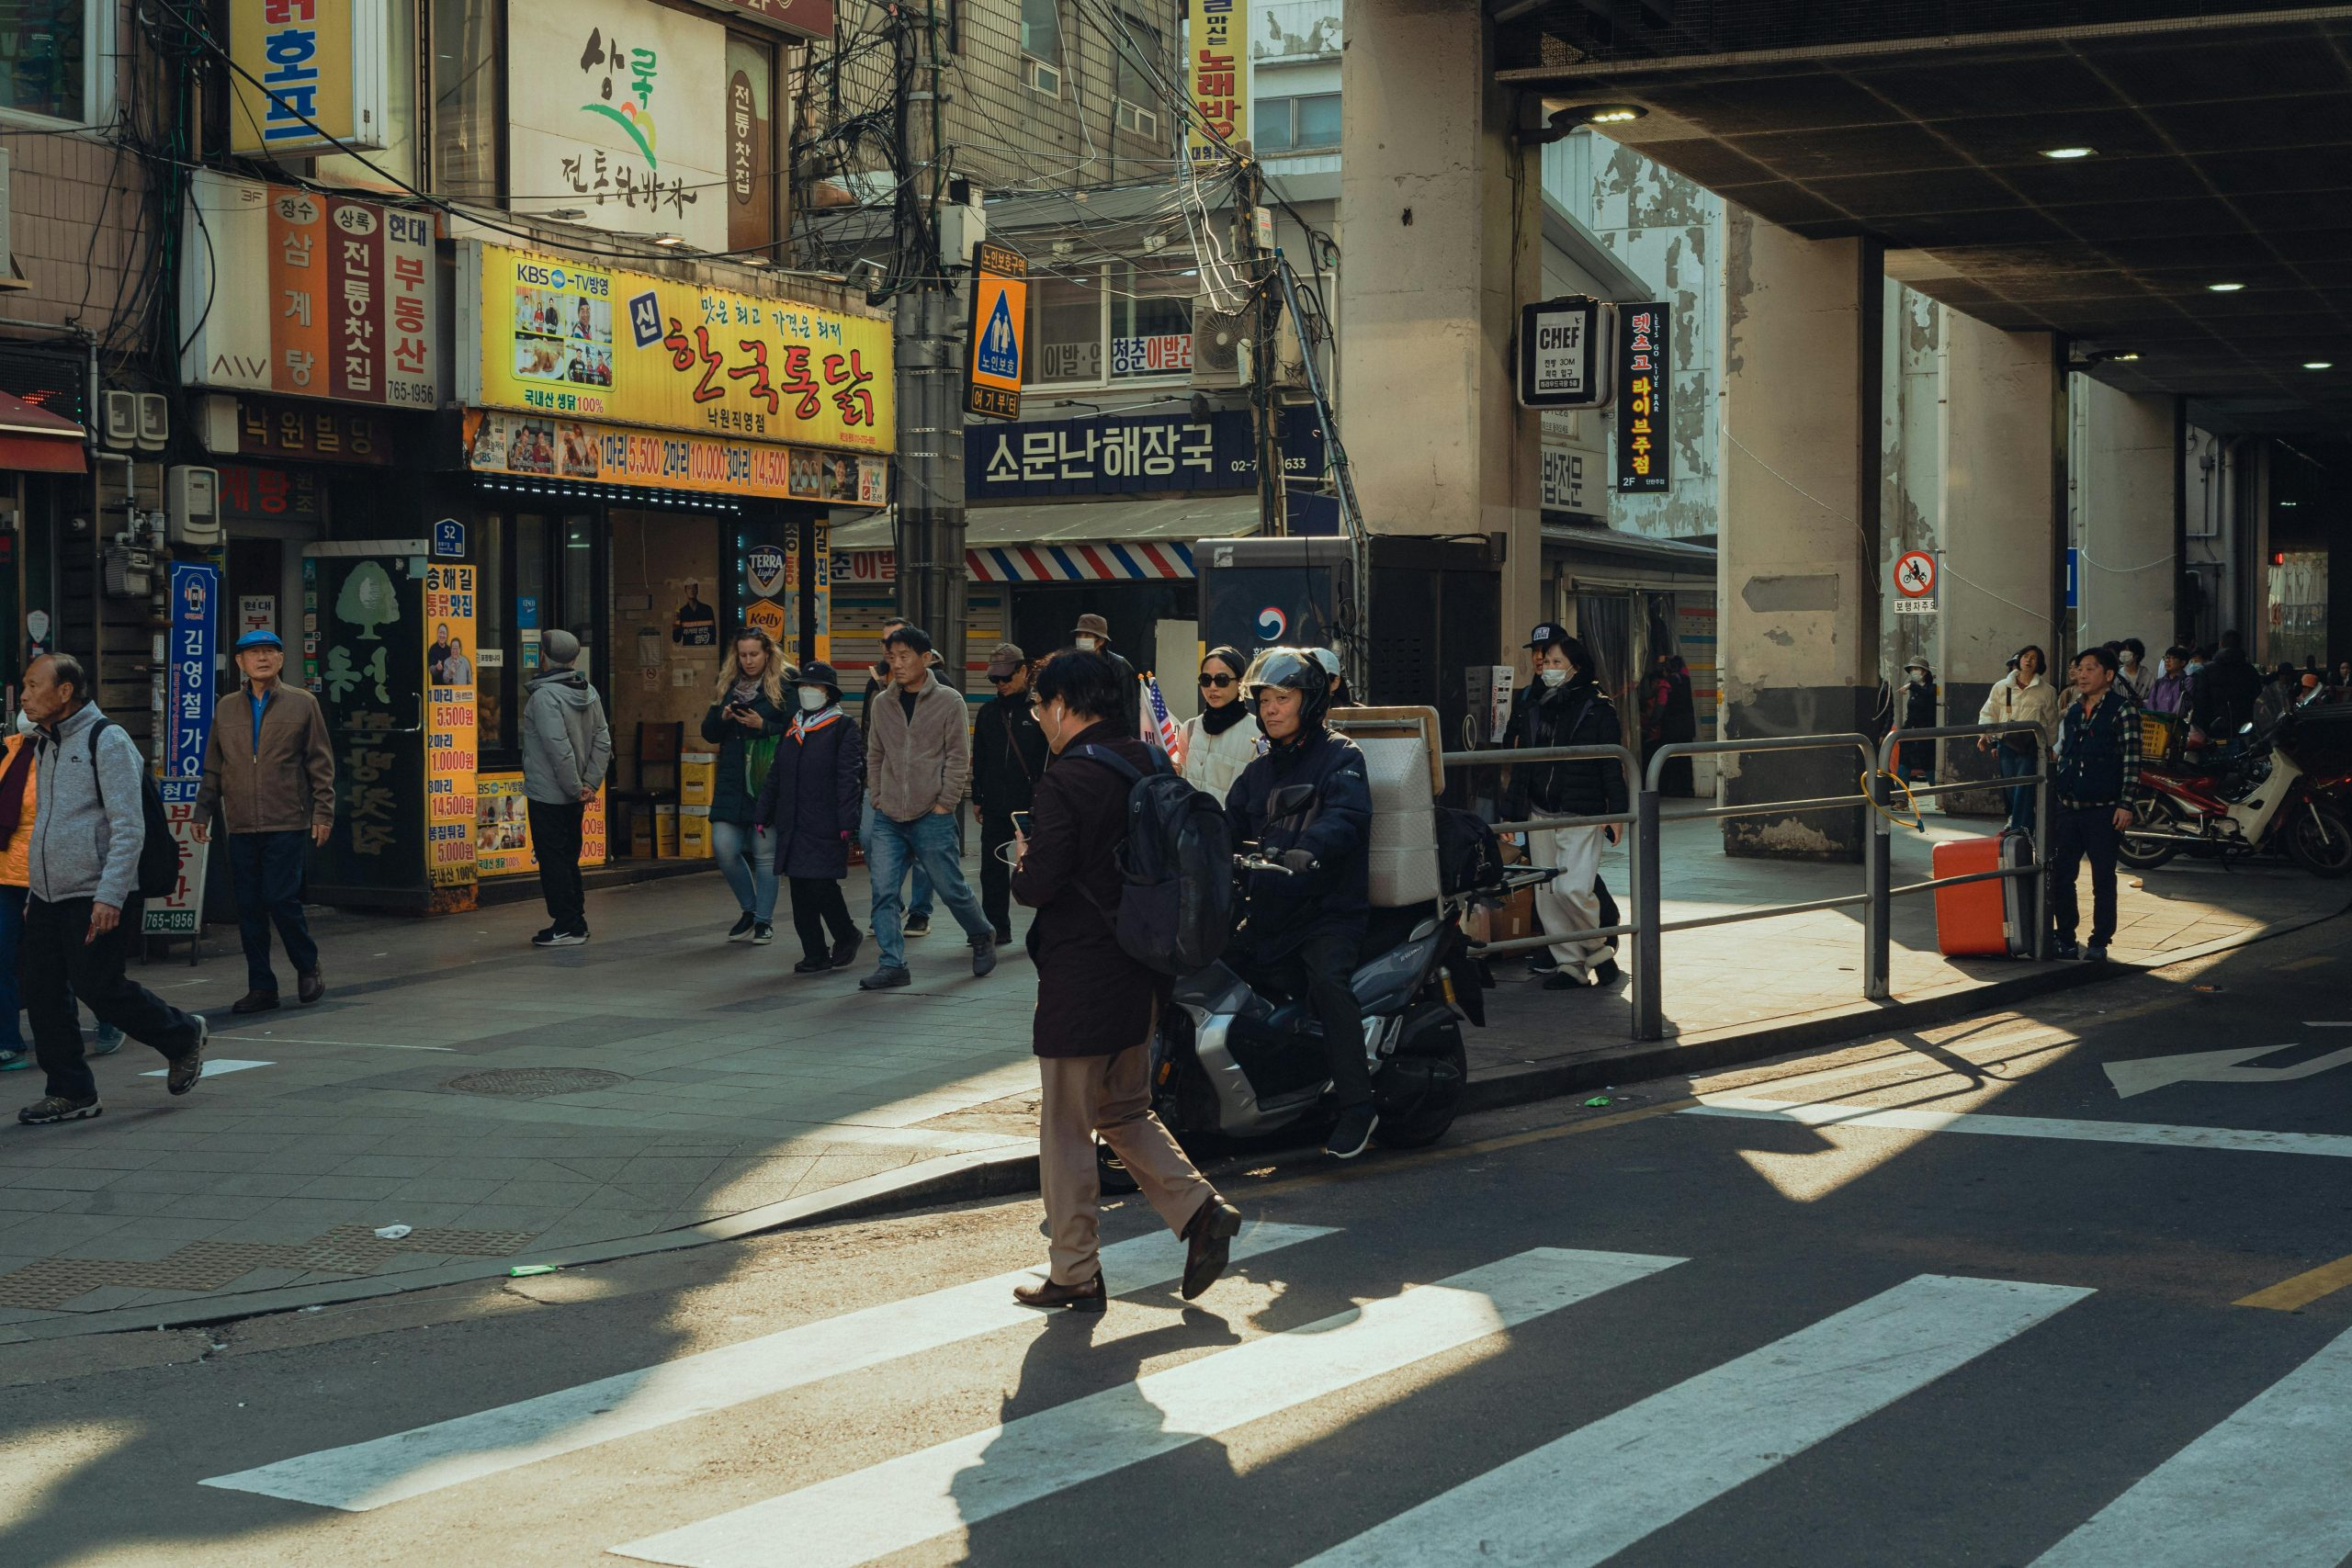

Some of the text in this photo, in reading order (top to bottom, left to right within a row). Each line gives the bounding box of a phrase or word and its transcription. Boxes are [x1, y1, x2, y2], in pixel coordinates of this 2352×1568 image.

[1205, 16, 1228, 45] 마시는
[580, 27, 657, 109] 상록
[1198, 49, 1241, 121] 노래바
[734, 85, 751, 195] 전통찻집
[241, 189, 263, 204] 3F
[280, 198, 313, 220] 장수
[340, 209, 370, 231] 상록
[388, 212, 427, 247] 현대
[982, 248, 1025, 277] 노인보호구역
[516, 263, 549, 286] KBS
[282, 231, 315, 388] 삼계탕
[343, 240, 374, 392] 전통찻집
[393, 254, 428, 375] 부동산
[635, 299, 658, 339] 신
[701, 295, 842, 346] 맛은 최고 가격은 최저
[1539, 326, 1580, 351] CHEF
[1631, 312, 1652, 370] 렛츠고
[1653, 344, 1659, 356] GO
[663, 317, 875, 426] 한국통닭
[981, 354, 1014, 375] 노인보호
[387, 379, 434, 404] 765-1956
[524, 389, 554, 409] 국내산
[245, 405, 372, 454] 낙원빌딩
[707, 408, 765, 434] 낙원직영점
[599, 432, 786, 489] 1마리 5,500 2마리 10,000 3마리 14,500
[1541, 451, 1583, 508] 밥전문
[1623, 477, 1635, 486] 2F
[444, 525, 456, 539] 52
[749, 554, 784, 569] TERRA
[427, 567, 472, 592] 송해길
[243, 601, 272, 612] 현대
[427, 593, 472, 617] 통닭맛집
[750, 613, 782, 628] Kelly
[428, 689, 453, 703] 1마리
[436, 706, 474, 727] 5,500원
[428, 733, 453, 749] 2마리
[432, 750, 474, 772] 1,0000원
[428, 779, 453, 794] 3마리
[432, 795, 474, 817] 14,500원
[437, 841, 474, 863] 5,000원
[430, 868, 454, 884] 국내산
[146, 913, 194, 929] 765-1956
